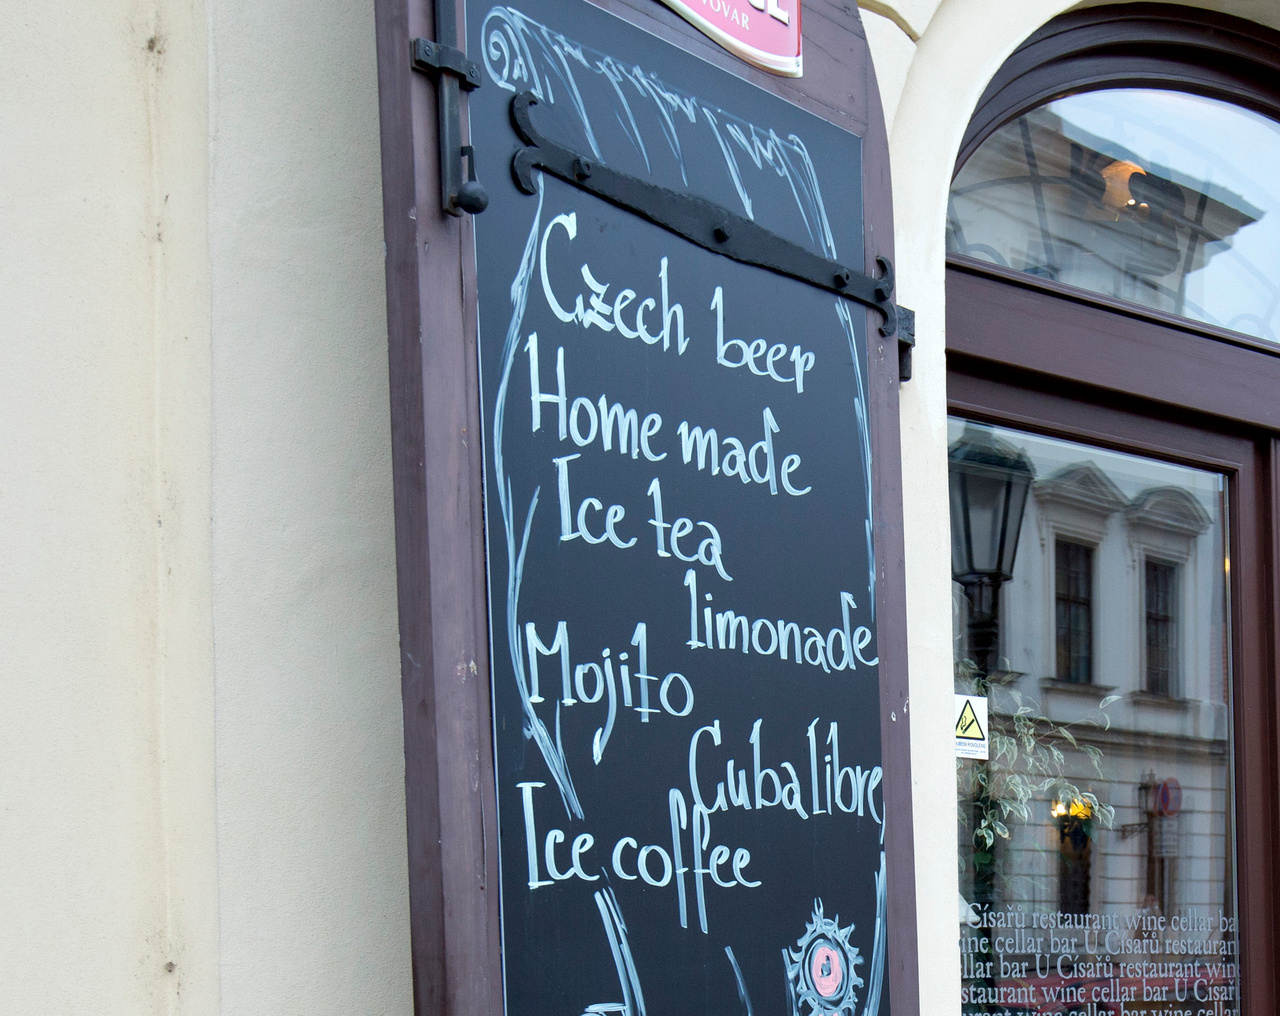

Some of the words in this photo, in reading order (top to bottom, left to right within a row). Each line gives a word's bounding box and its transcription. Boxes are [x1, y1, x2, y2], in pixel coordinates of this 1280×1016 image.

[540, 212, 688, 355] Czech
[711, 287, 815, 393] beer
[524, 332, 667, 462] Home
[678, 407, 812, 496] made
[552, 453, 637, 548] Ice
[648, 478, 733, 581] tea
[525, 621, 694, 765] Mojito
[690, 718, 808, 819] Cuba
[807, 718, 882, 824] libre
[516, 781, 599, 888] Ice
[612, 788, 761, 933] coffee
[966, 903, 1024, 929] Císařů
[1032, 911, 1118, 930] restaurant
[1124, 909, 1166, 931] wine
[1171, 908, 1213, 931] cellar
[995, 929, 1043, 953] cellar
[1051, 930, 1078, 953] bar
[1084, 930, 1098, 953] U
[1105, 930, 1159, 955] Císařů
[1000, 956, 1028, 978] bar
[1035, 954, 1050, 978] U
[1057, 953, 1113, 979] Císařů
[1120, 959, 1200, 978] restaurant
[1041, 980, 1086, 1003] wine
[1091, 980, 1136, 1002] cellar
[1143, 978, 1168, 1001] bar
[1174, 978, 1188, 1002] U
